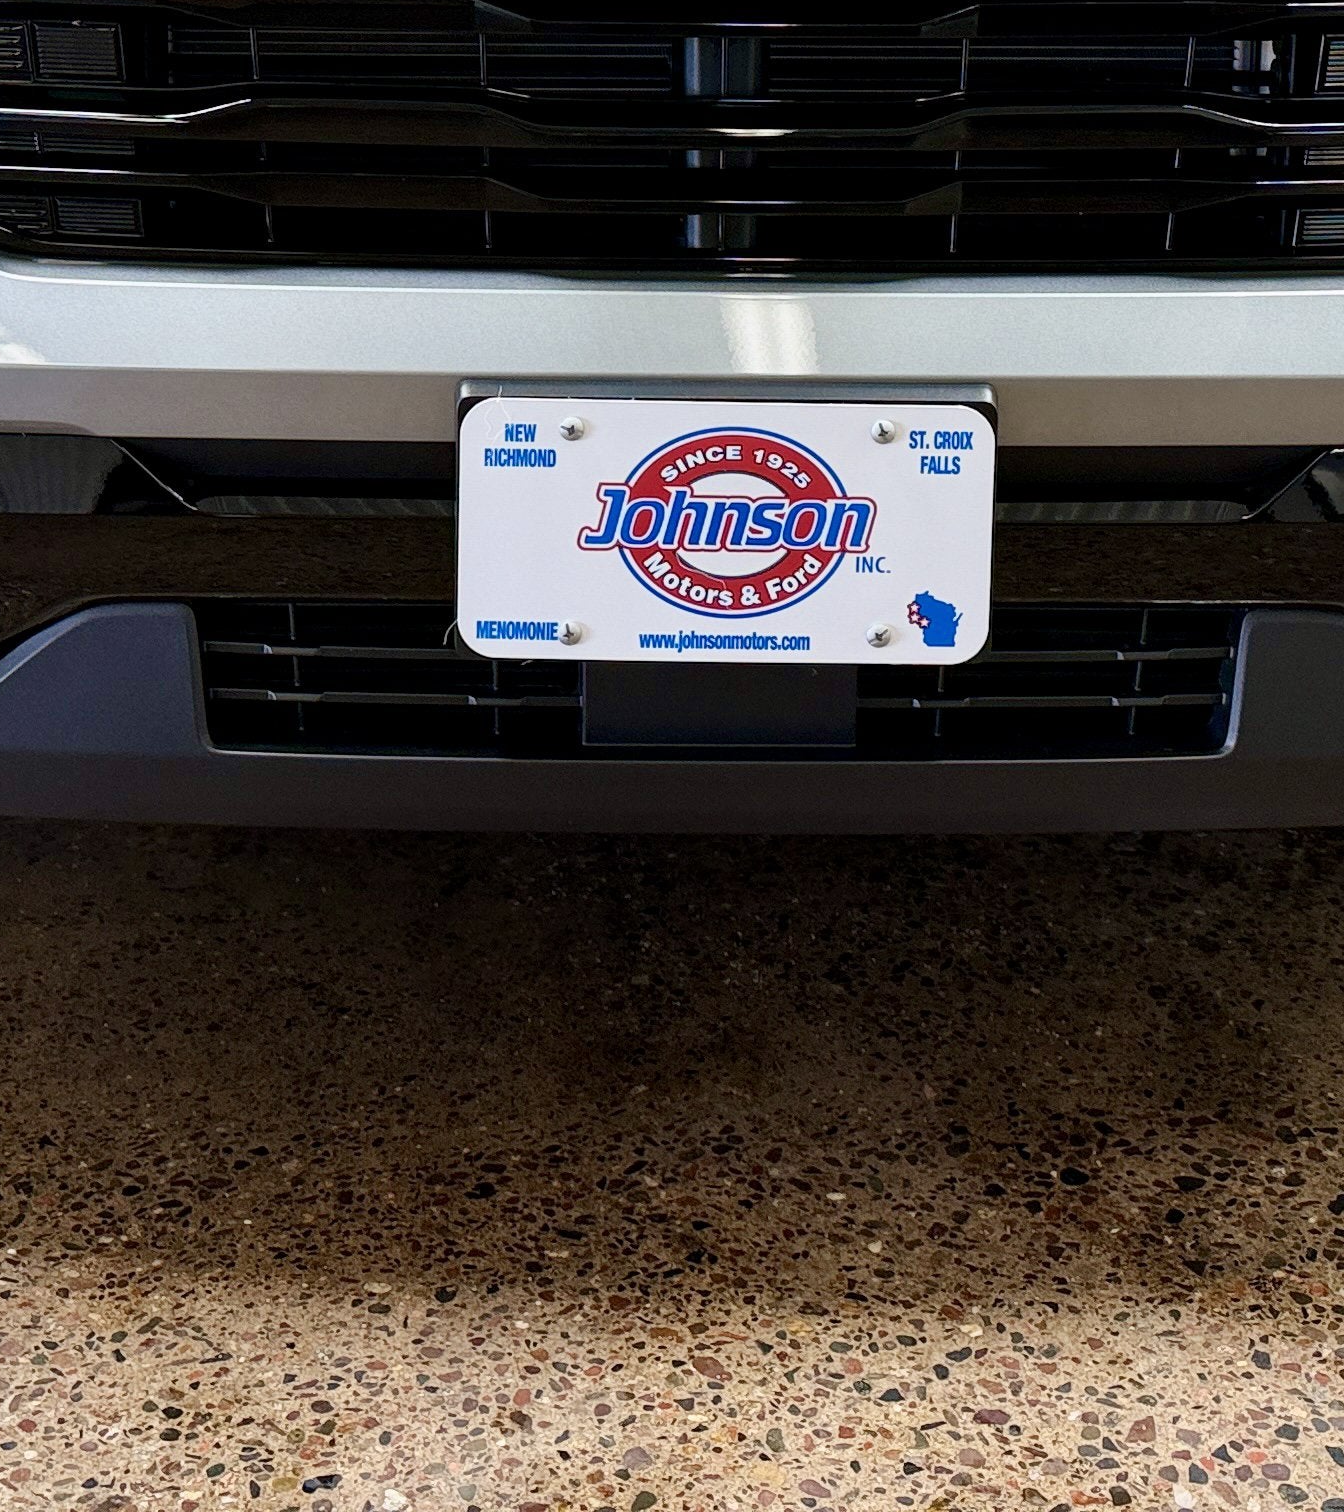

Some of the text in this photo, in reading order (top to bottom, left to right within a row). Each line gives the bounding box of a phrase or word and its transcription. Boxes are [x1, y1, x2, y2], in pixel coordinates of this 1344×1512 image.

[504, 423, 537, 443] NEW
[909, 430, 974, 450] ST. CROIX
[484, 448, 557, 468] RICHMOND
[659, 444, 812, 490] SINCE 1925
[920, 455, 961, 475] FALLS
[582, 487, 873, 550] Johnson
[855, 556, 891, 574] INC.
[643, 551, 823, 607] Motors & Ford
[476, 620, 559, 641] MENOMONIE
[638, 630, 811, 653] www.johnsonmotors.com
